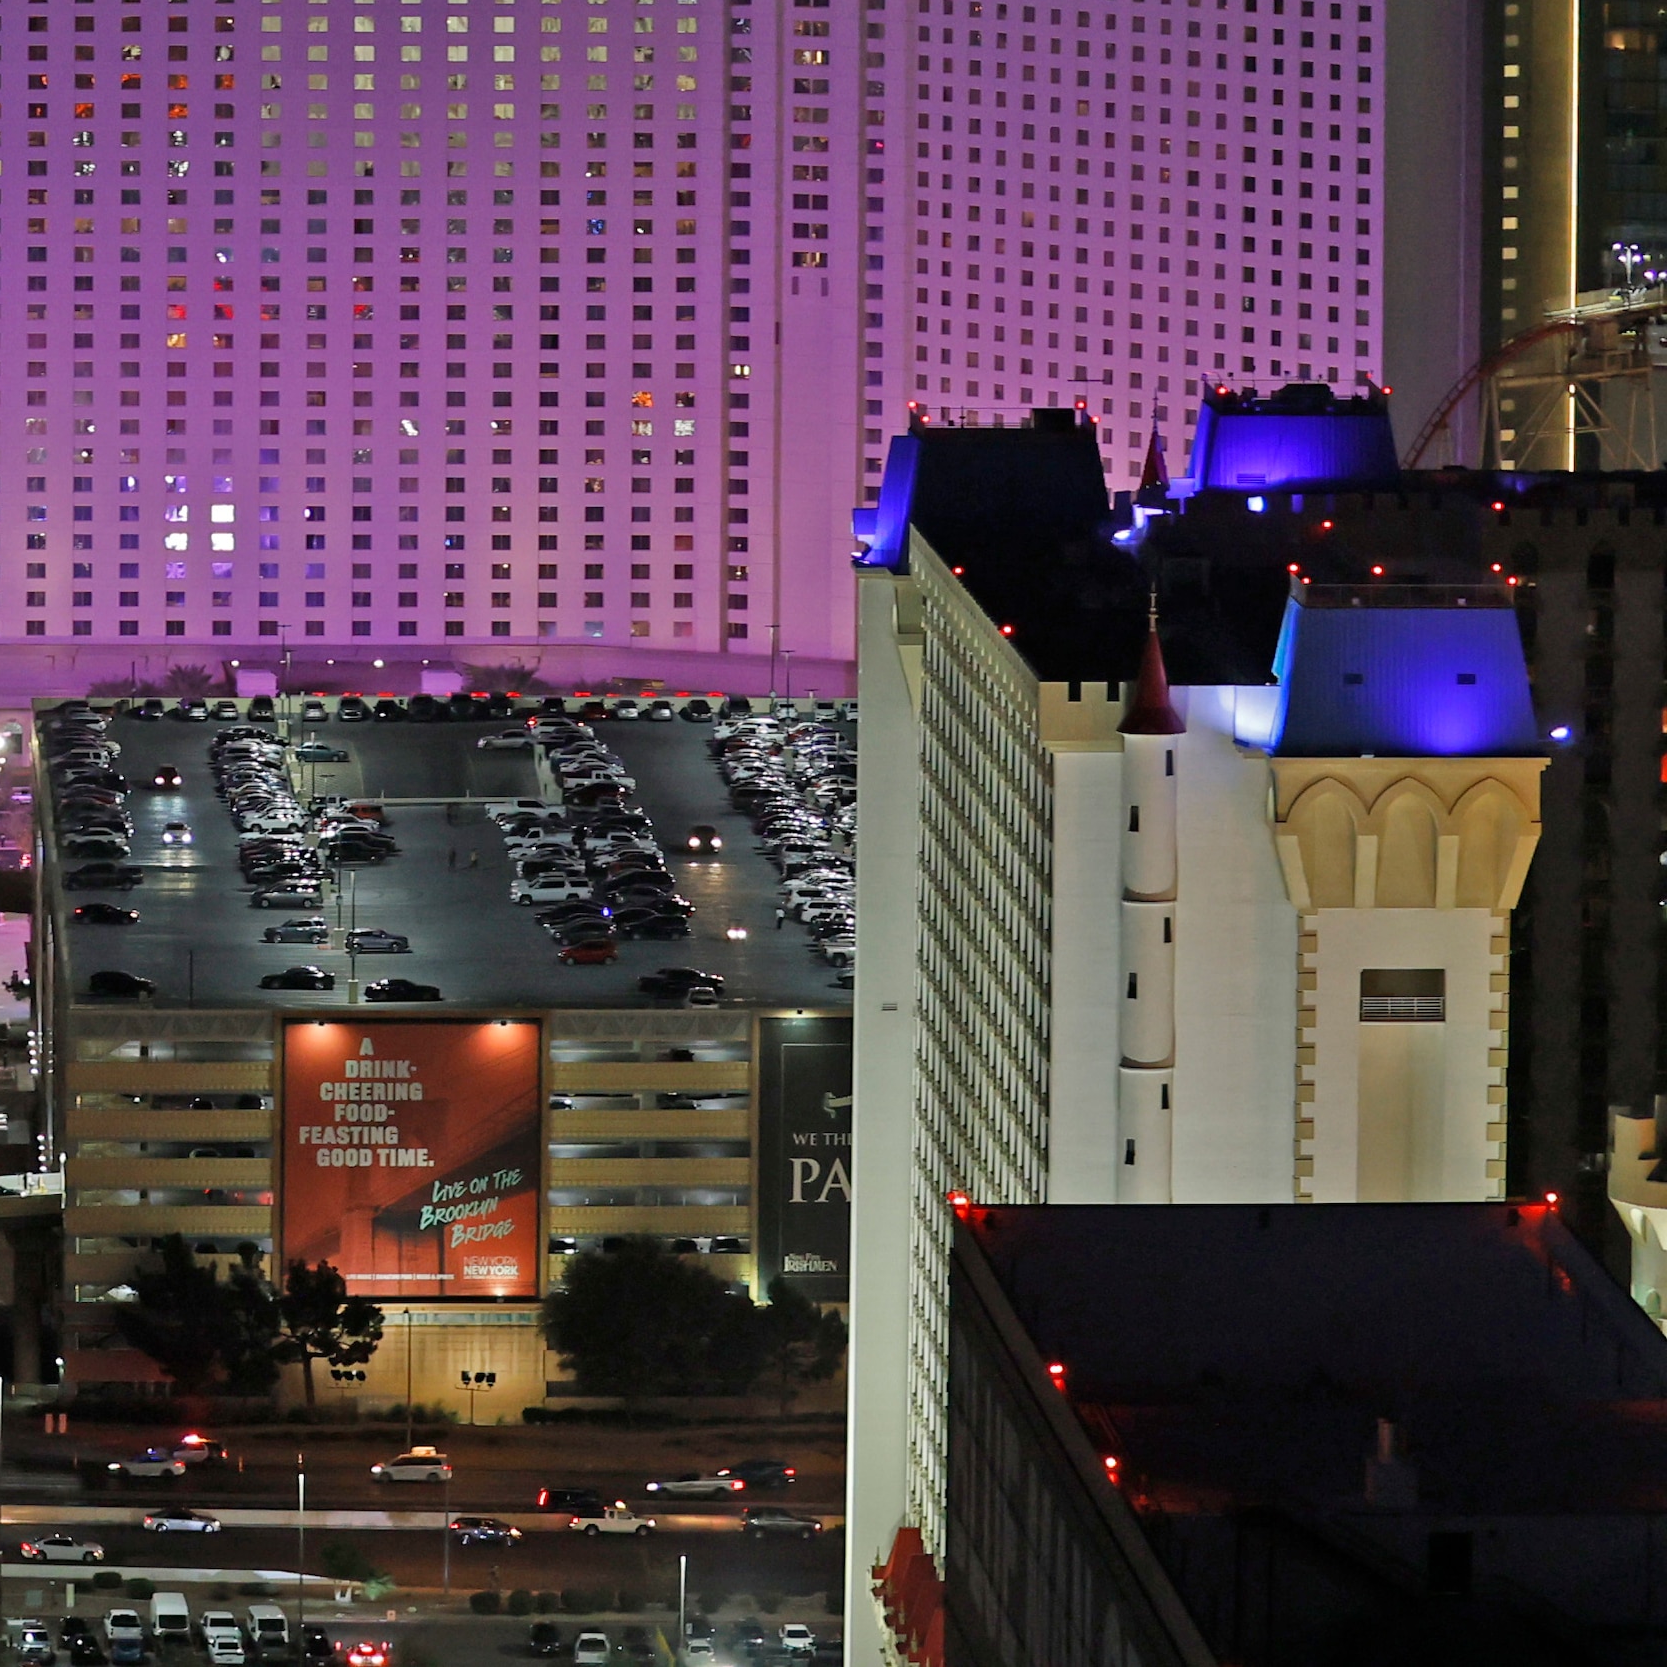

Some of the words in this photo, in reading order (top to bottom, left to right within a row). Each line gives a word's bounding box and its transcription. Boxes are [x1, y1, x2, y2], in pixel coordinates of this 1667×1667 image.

[359, 1037, 375, 1056] A
[345, 1060, 417, 1079] DRINK-
[320, 1082, 423, 1101] CHEERING
[334, 1103, 395, 1122] FOOD-
[299, 1126, 399, 1145] FEASTING
[792, 1132, 817, 1146] WE
[317, 1148, 373, 1167] GOOD
[376, 1148, 435, 1167] TIME.
[463, 1265, 488, 1275] NEW
[488, 1265, 520, 1275] YORK
